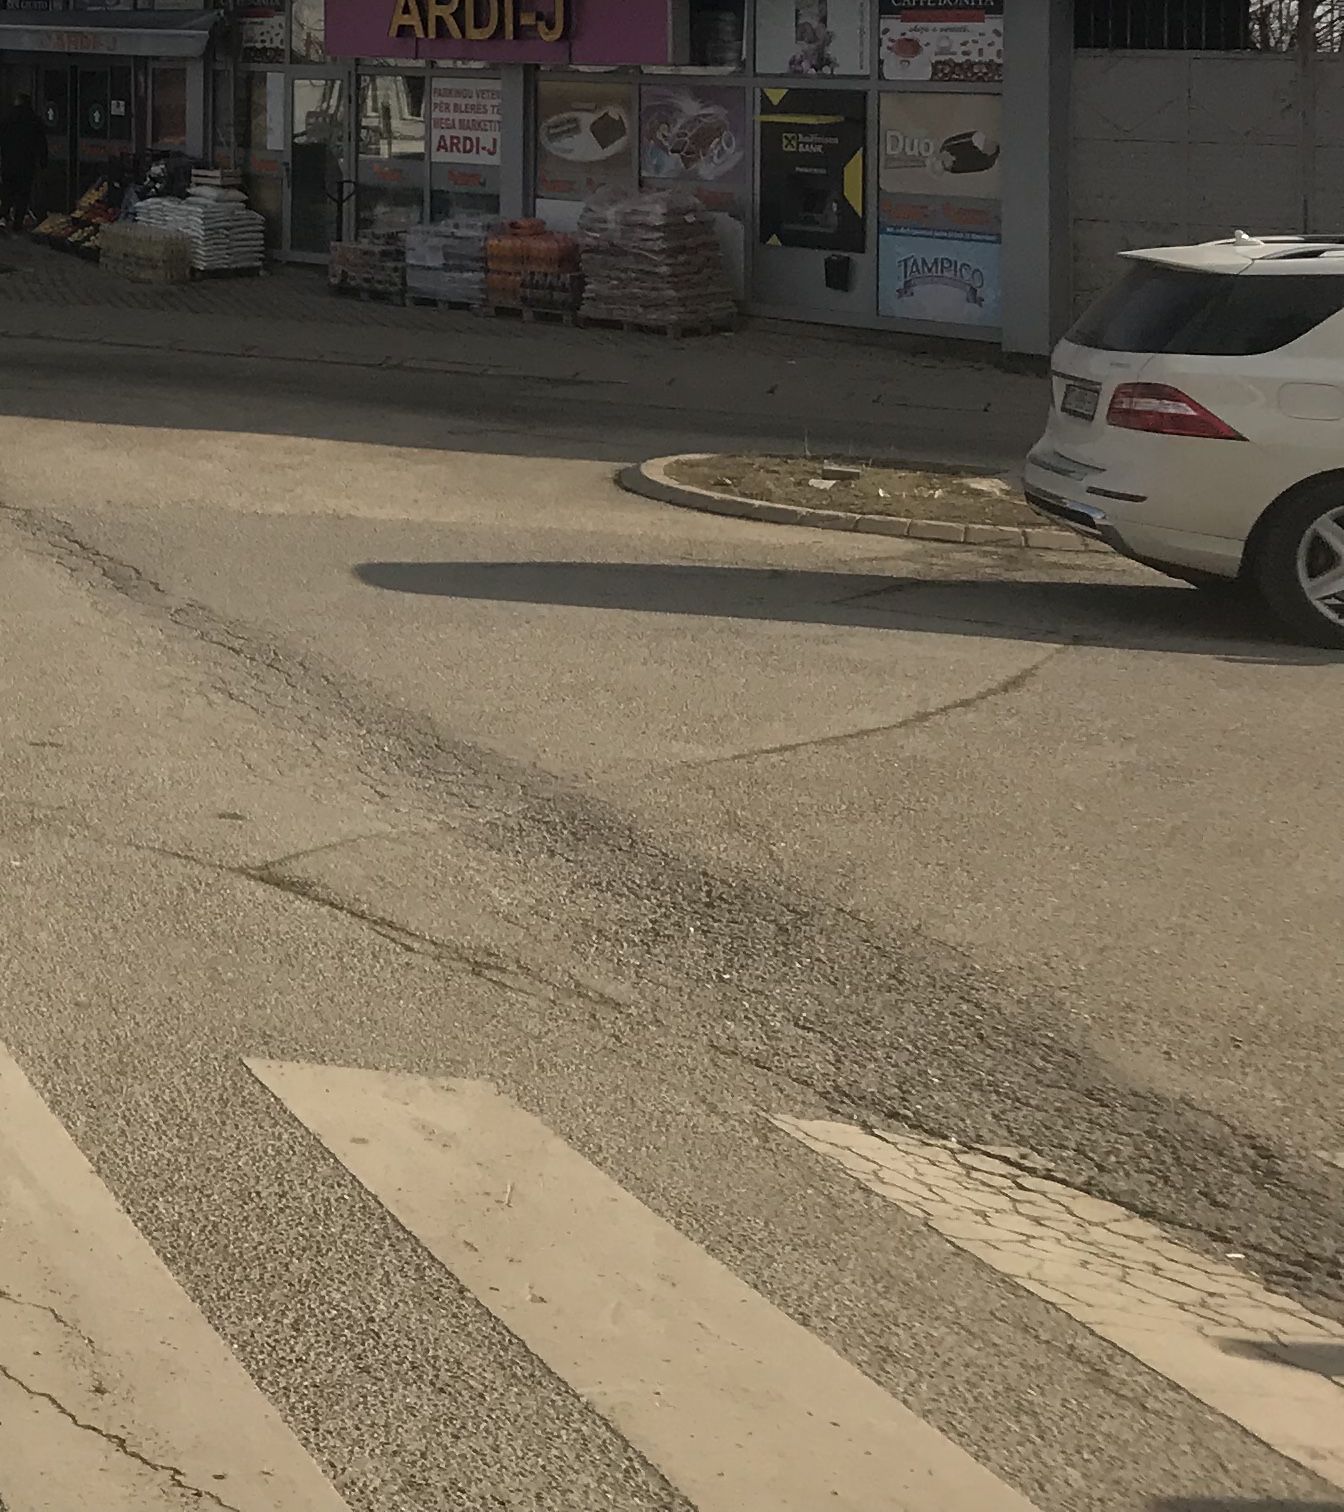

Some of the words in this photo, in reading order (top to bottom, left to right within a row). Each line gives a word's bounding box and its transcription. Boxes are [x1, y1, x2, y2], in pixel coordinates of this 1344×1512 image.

[436, 135, 498, 156] ARDI-J
[799, 143, 824, 153] BANK
[886, 131, 935, 157] Duo
[897, 255, 984, 290] TAMPICO
